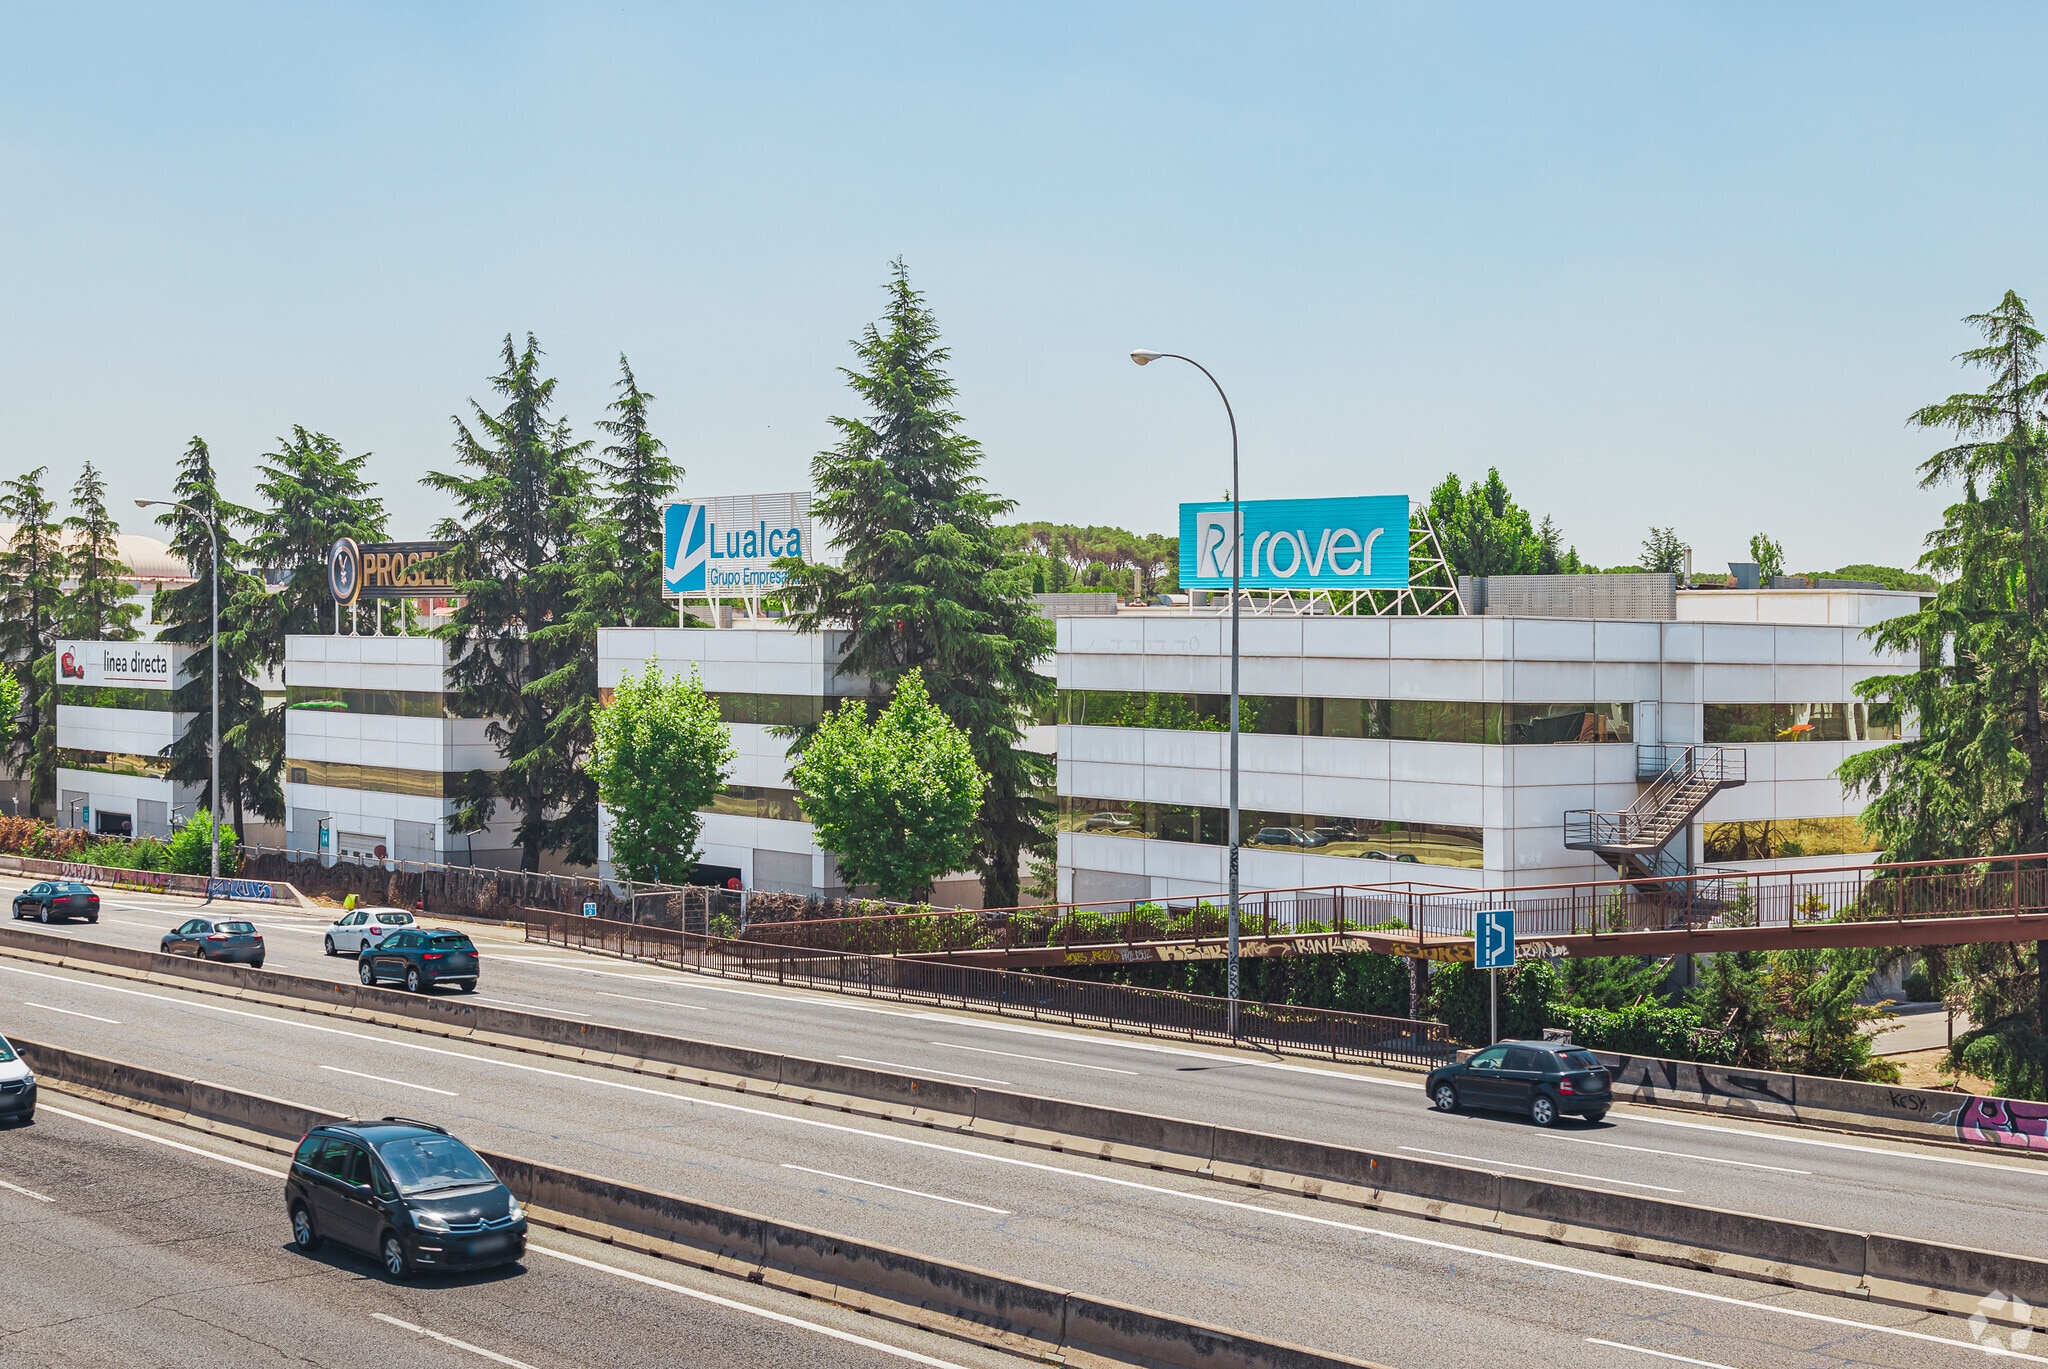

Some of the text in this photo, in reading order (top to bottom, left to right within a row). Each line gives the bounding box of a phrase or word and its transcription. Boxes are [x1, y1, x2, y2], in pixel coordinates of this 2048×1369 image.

[710, 520, 802, 558] Lualca
[1251, 527, 1385, 578] rover
[710, 567, 741, 588] Grupo
[103, 649, 167, 673] linea directa
